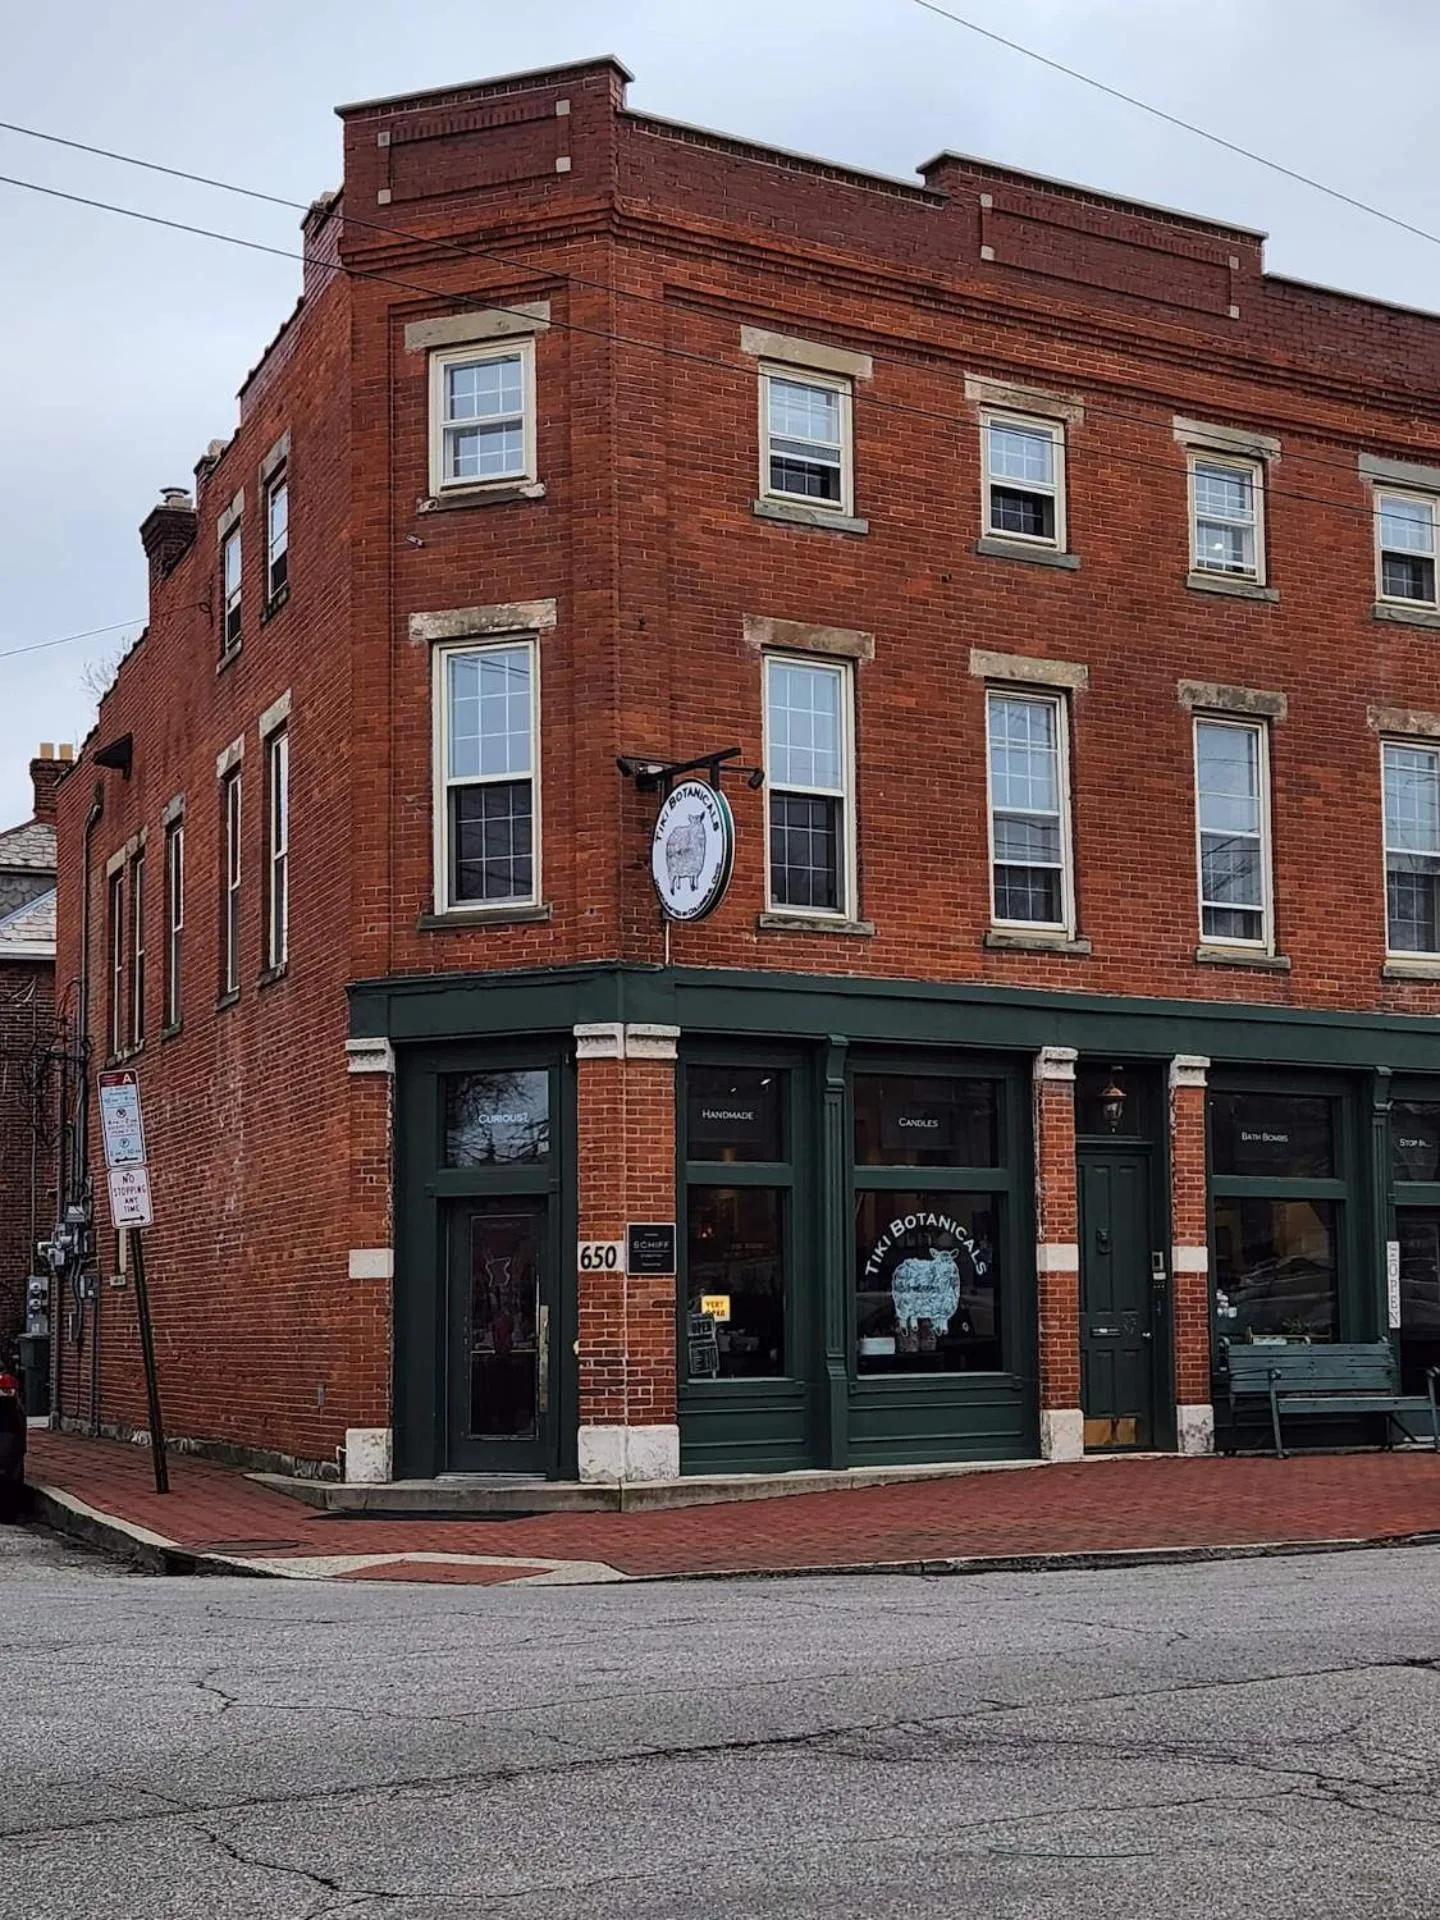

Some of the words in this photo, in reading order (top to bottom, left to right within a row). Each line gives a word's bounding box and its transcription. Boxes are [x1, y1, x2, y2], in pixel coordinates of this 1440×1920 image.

[655, 811, 669, 842] TIKI
[668, 787, 719, 832] BOTANICALS
[122, 1073, 133, 1084] A
[702, 1109, 754, 1120] HANDMADE
[898, 1117, 939, 1127] CANDLES
[122, 1175, 135, 1184] NO
[113, 1184, 146, 1197] STOPPING
[633, 1241, 669, 1250] SCHIFF
[865, 1235, 892, 1275] TIKI
[889, 1212, 987, 1276] BOTANICALS
[580, 1245, 617, 1270] 650
